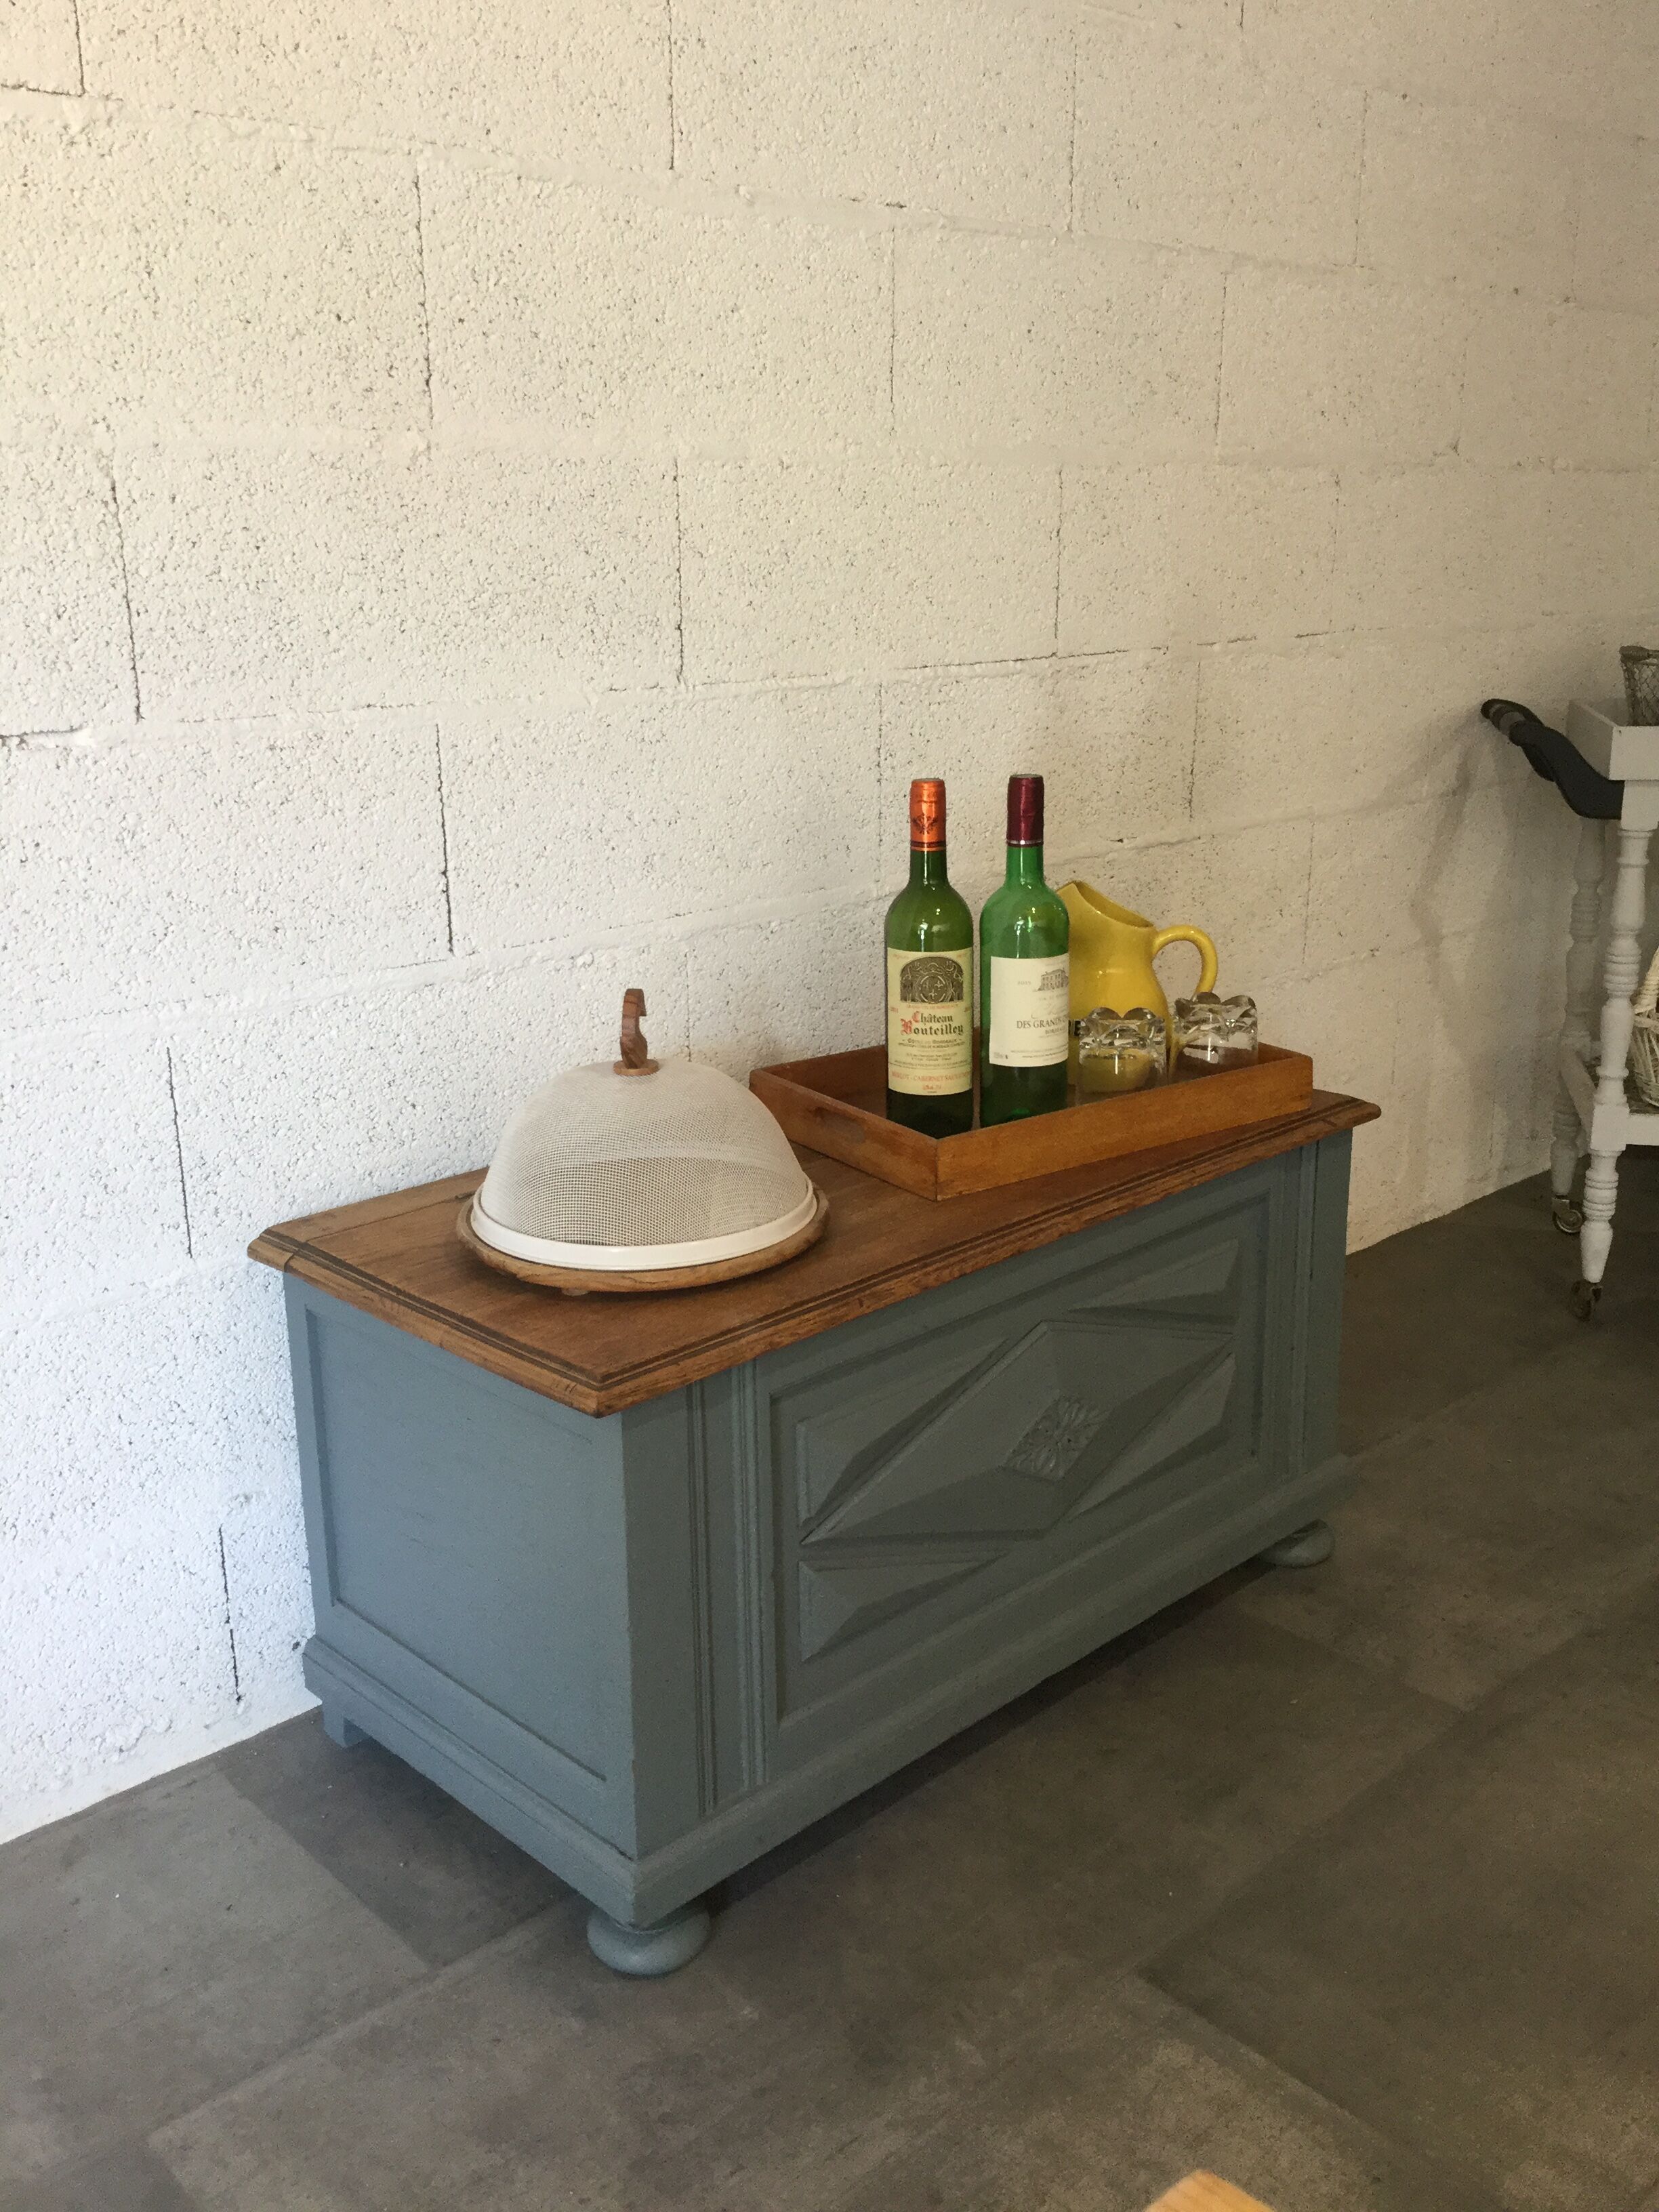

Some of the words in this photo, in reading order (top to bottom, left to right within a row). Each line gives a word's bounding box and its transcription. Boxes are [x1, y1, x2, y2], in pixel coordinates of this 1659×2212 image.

[912, 1010, 954, 1023] Château
[900, 1018, 964, 1036] Bouteilley
[1017, 1020, 1031, 1029] DES
